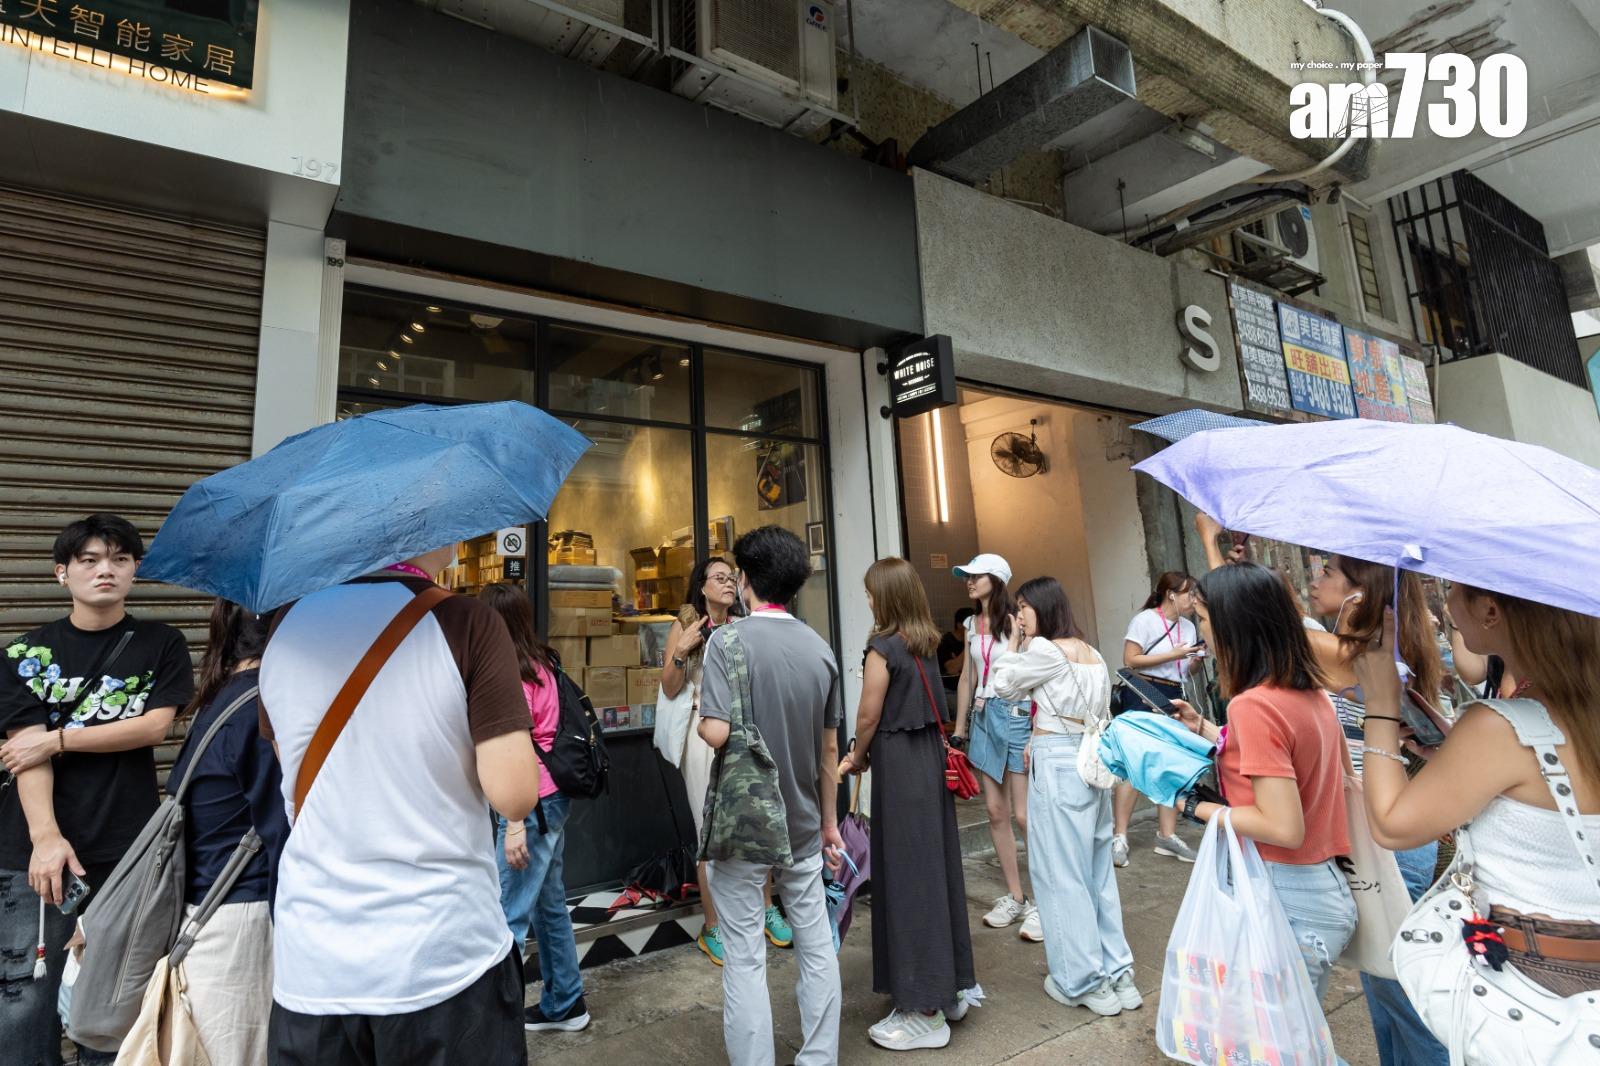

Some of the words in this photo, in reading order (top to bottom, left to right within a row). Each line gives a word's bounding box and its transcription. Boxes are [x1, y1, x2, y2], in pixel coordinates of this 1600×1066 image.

[128, 54, 209, 94] HOME
[290, 156, 337, 183] 197
[325, 256, 344, 269] 199
[1177, 304, 1220, 372] S
[1299, 314, 1340, 348] 美居物業
[893, 364, 914, 380] WHITE
[915, 357, 935, 373] NOISE
[1290, 348, 1345, 381] 旺舖出租
[1306, 374, 1330, 411] 5488
[1331, 381, 1354, 416] 9528
[509, 560, 520, 571] 推
